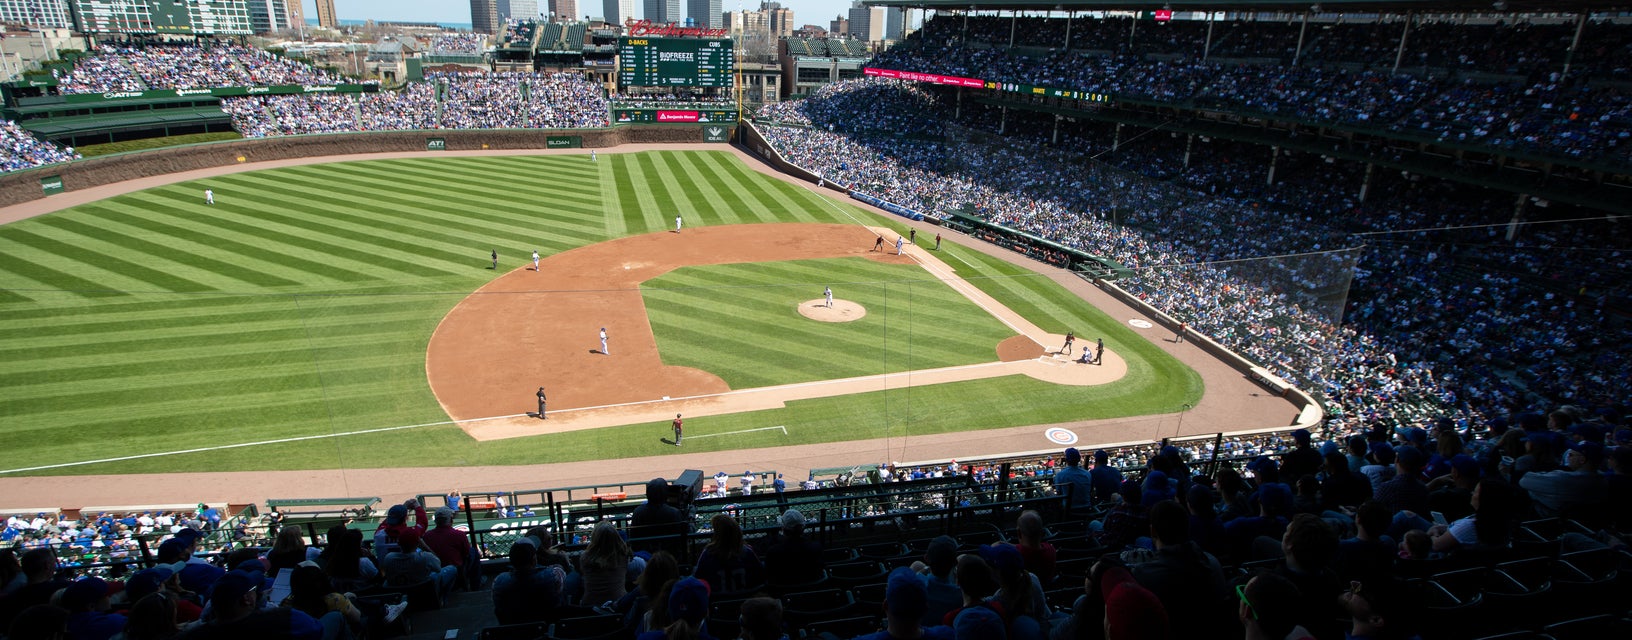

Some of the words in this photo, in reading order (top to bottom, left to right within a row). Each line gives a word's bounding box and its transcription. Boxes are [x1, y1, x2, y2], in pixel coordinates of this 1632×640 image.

[625, 19, 728, 37] Budweiser
[660, 51, 694, 59] BIOFREEZE
[899, 71, 910, 79] Paint
[428, 140, 444, 148] ATI
